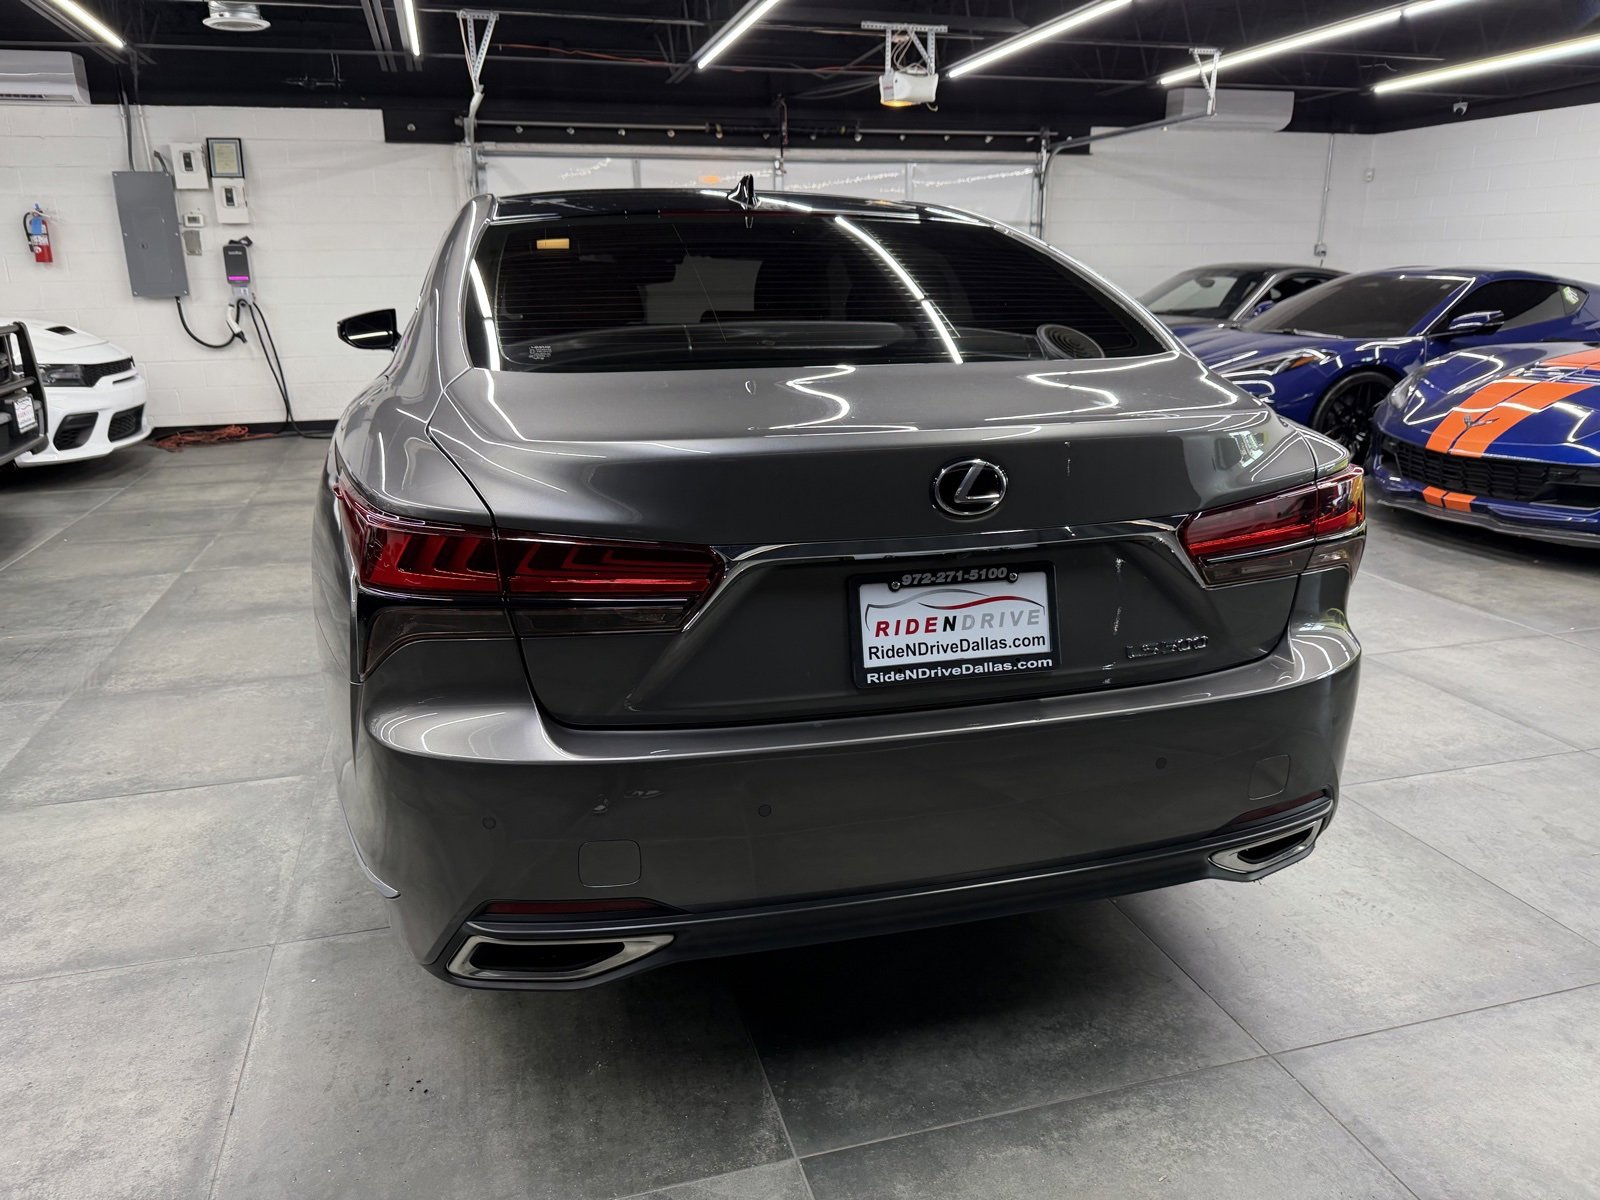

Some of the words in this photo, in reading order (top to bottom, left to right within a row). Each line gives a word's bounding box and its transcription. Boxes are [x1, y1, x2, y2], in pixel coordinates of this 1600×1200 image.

[902, 567, 1008, 586] 972-271-5100
[875, 609, 1041, 638] RIDENDRIVE
[868, 635, 1046, 660] RideNDriveDallas.com
[866, 657, 1053, 684] RideNDriveDallas.com
